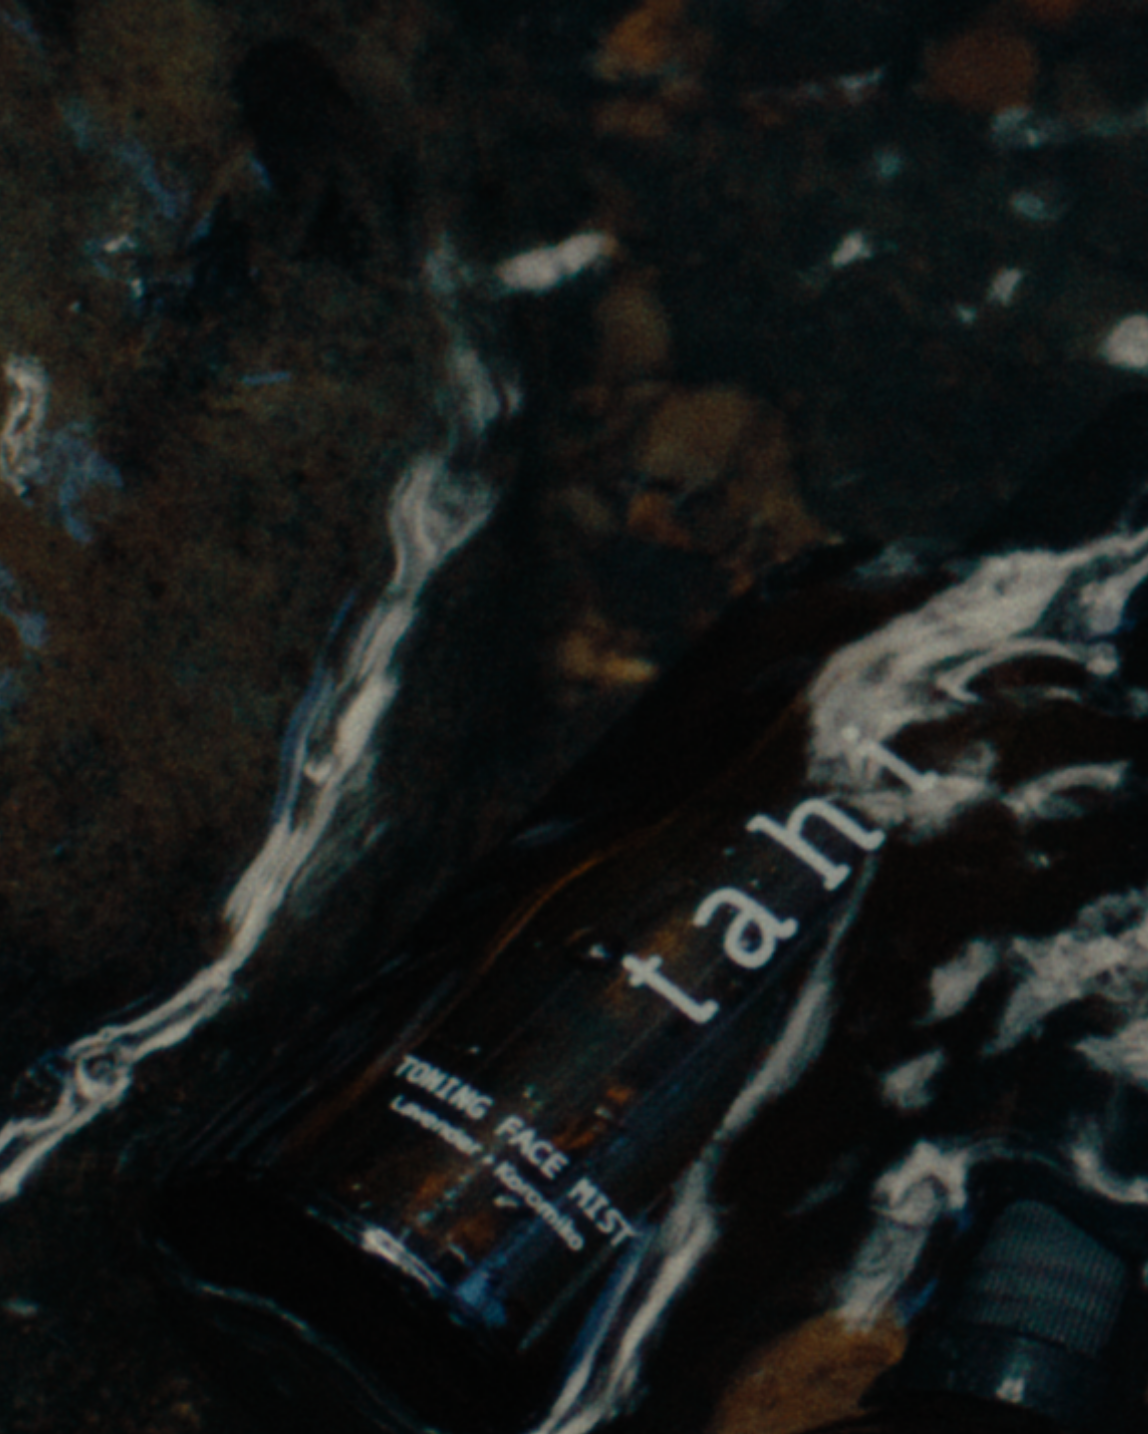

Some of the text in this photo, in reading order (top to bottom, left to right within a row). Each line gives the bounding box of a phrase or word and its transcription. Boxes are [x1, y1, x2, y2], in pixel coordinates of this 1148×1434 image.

[620, 725, 941, 1024] tahi
[394, 1053, 642, 1248] TONING FACE MIST
